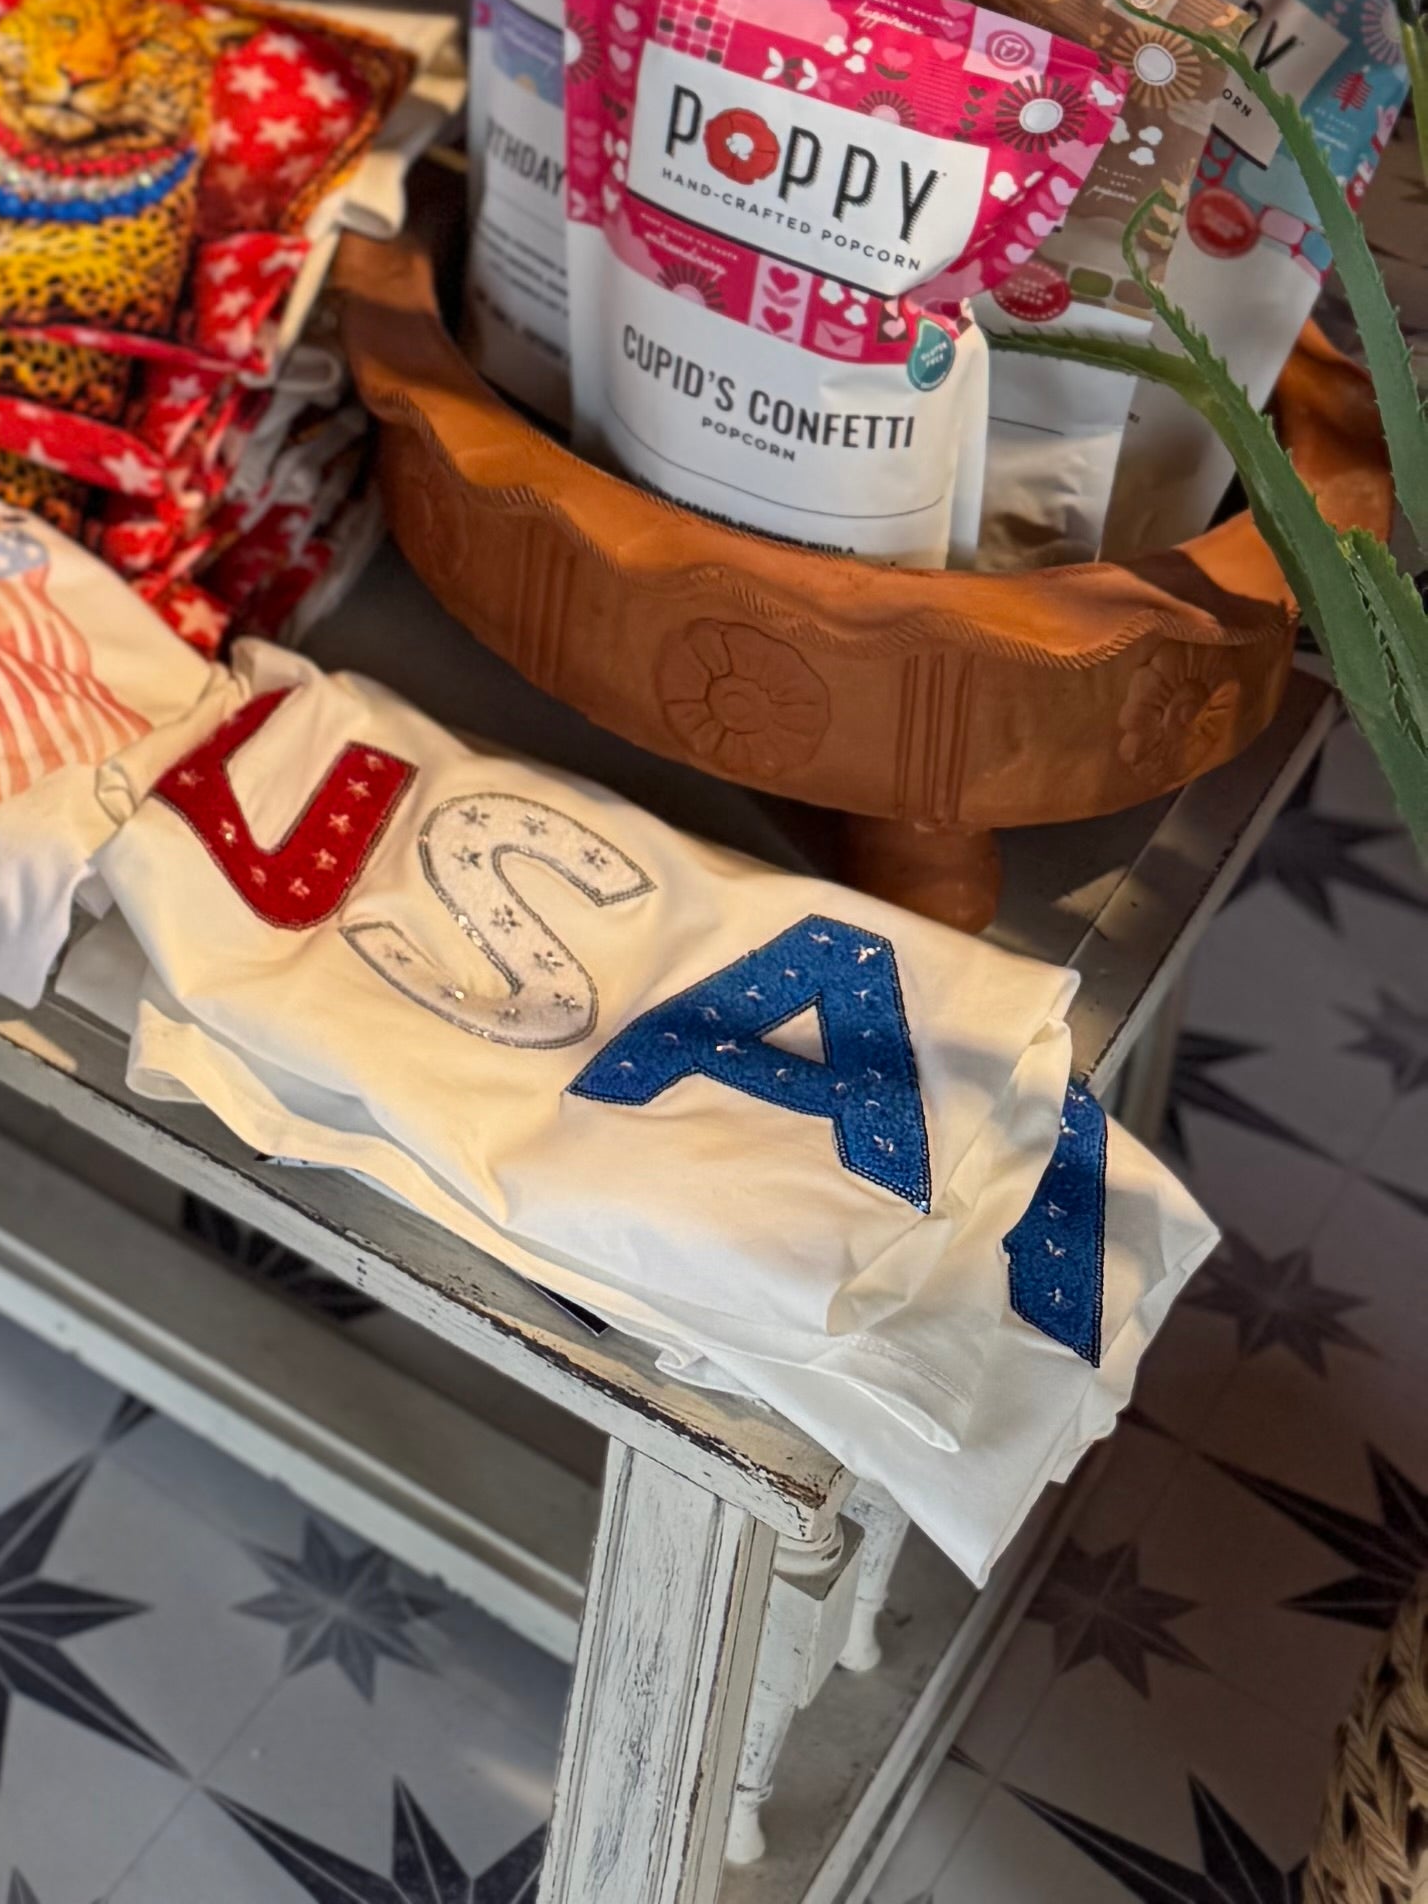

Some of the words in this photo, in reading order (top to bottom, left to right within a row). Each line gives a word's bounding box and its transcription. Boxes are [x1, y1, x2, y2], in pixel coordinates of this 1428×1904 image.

[662, 167, 812, 235] HAND-CRAFTED
[821, 229, 922, 272] POPCORN
[664, 84, 940, 244] POPPY
[623, 324, 737, 413] CUPID'S
[748, 389, 915, 449] CONFETTI
[701, 415, 797, 462] POPCORN
[150, 685, 933, 1215] USA
